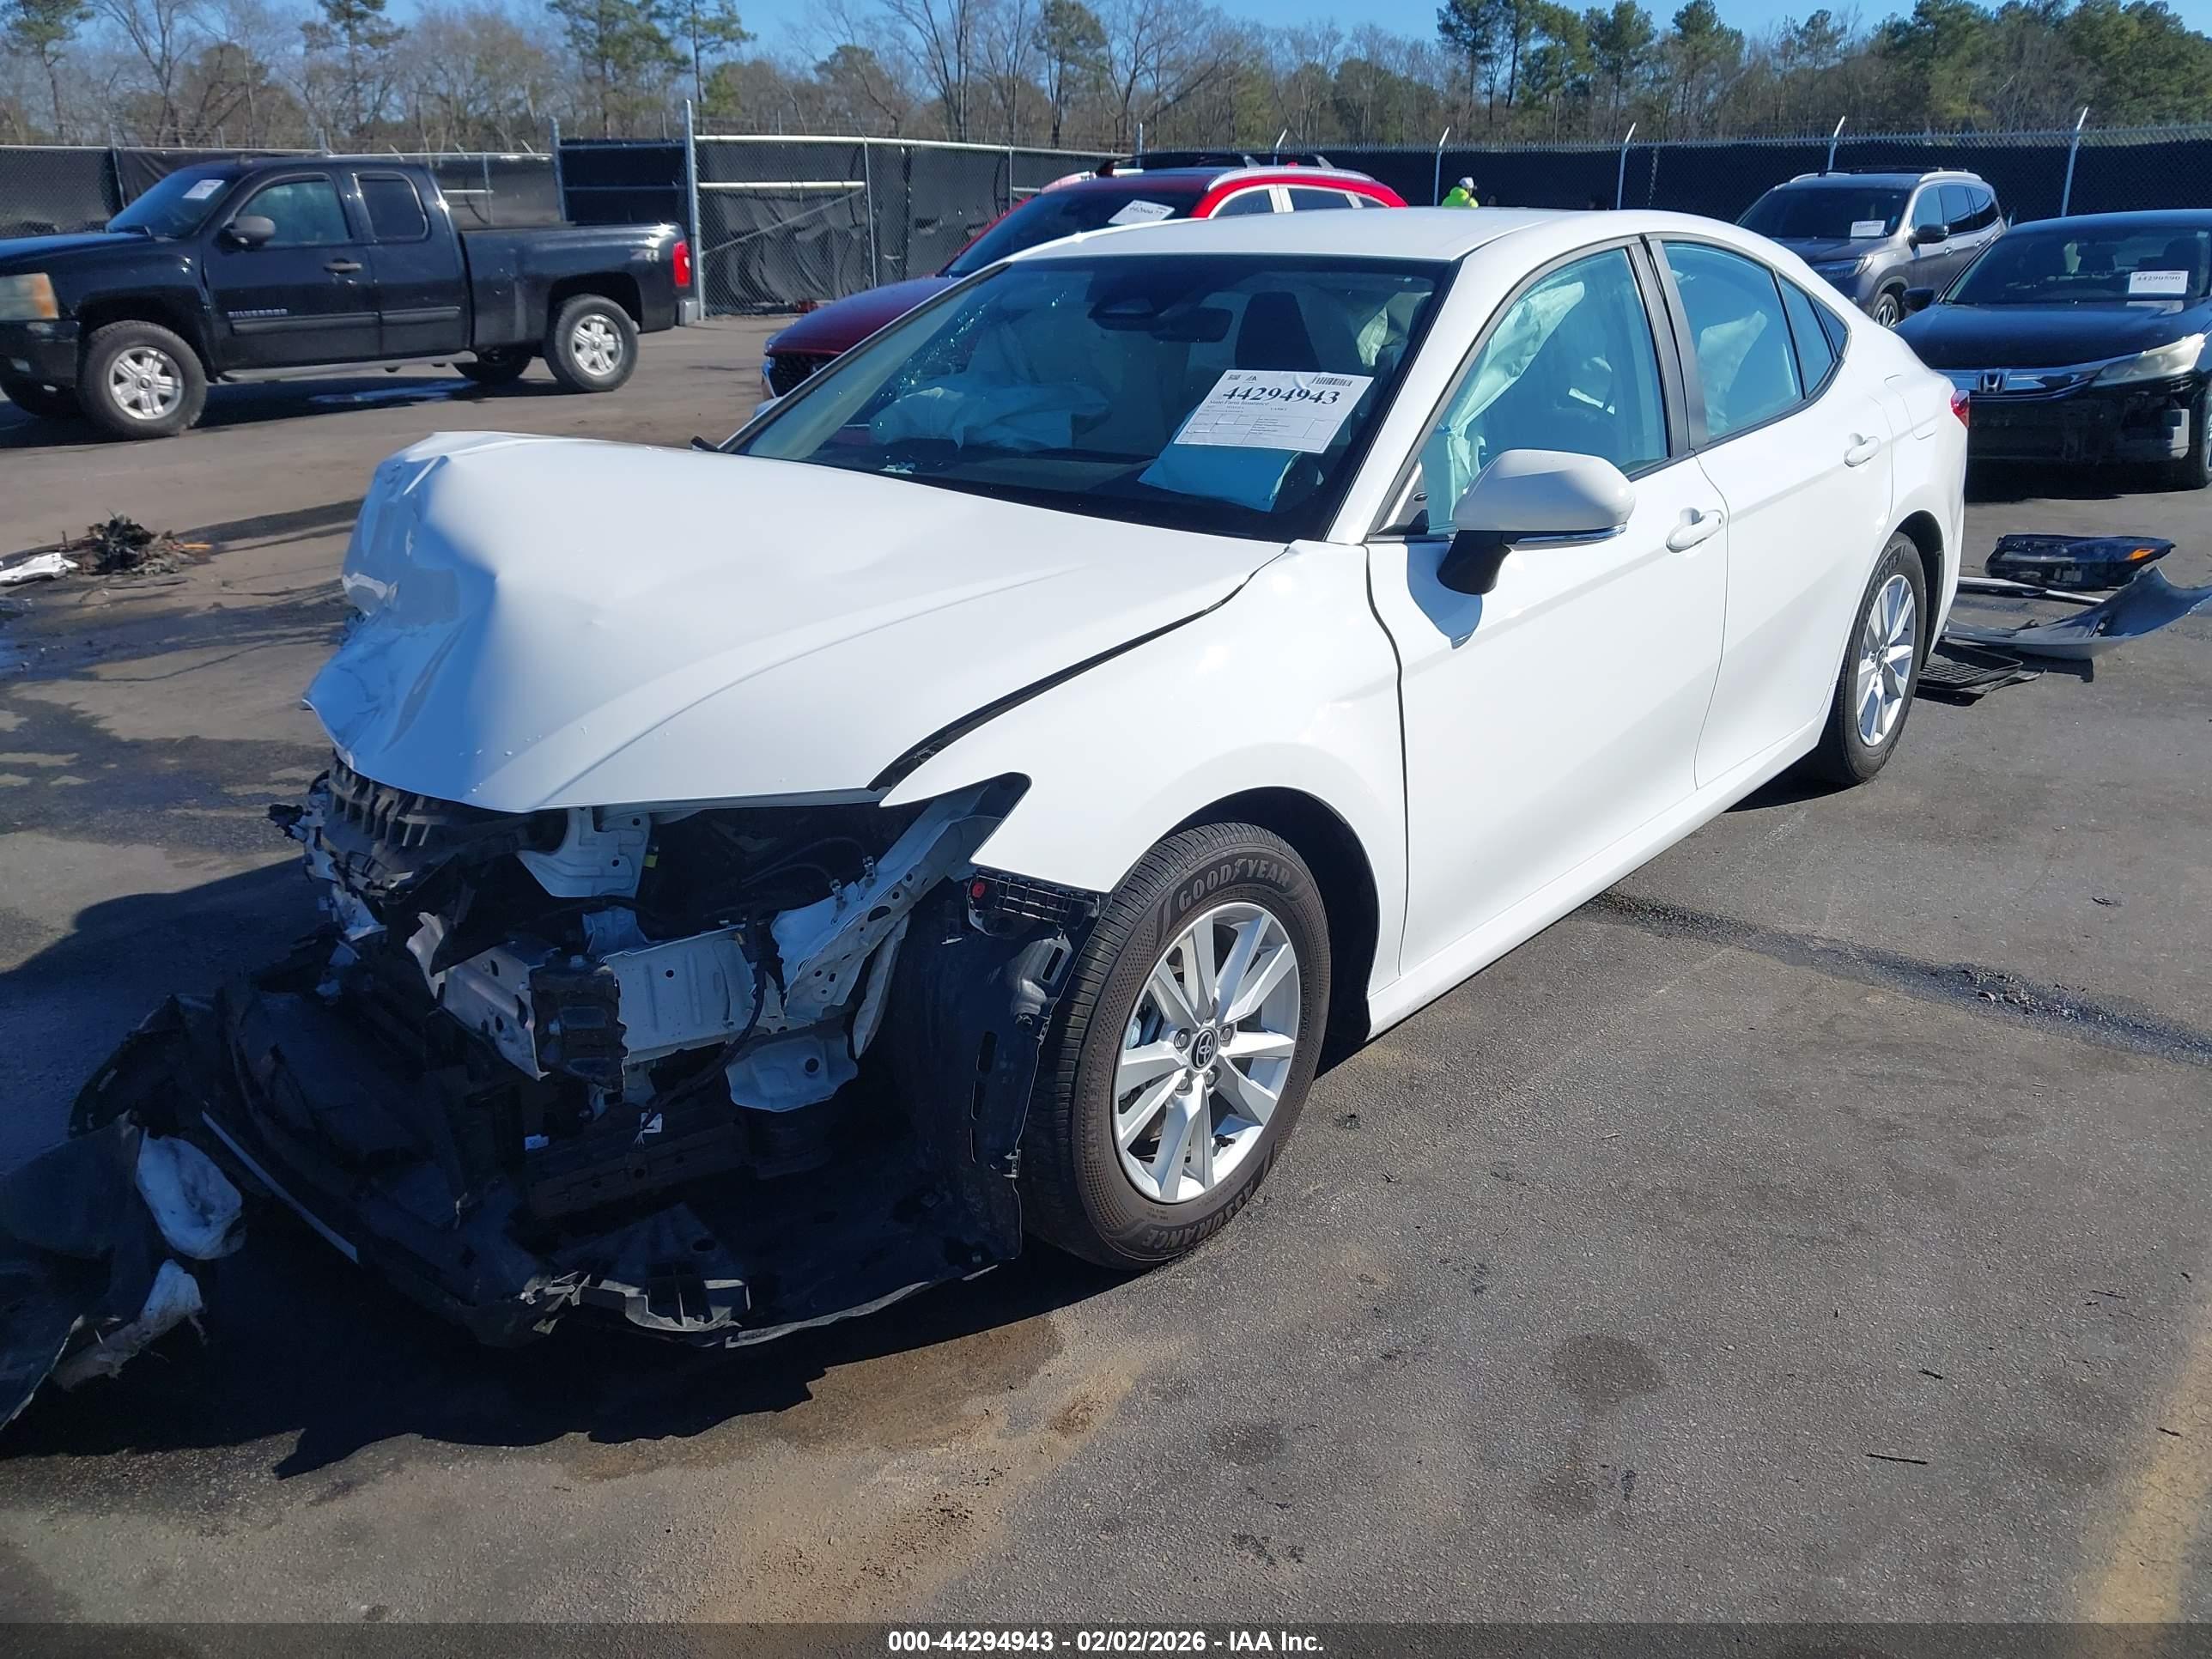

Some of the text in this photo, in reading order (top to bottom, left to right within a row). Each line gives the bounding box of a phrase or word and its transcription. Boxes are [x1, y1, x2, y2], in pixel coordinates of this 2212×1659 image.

[1223, 386, 1340, 404] 44294943
[1178, 859, 1291, 912] GOODYEAR
[1143, 1181, 1254, 1249] ASSURANCE
